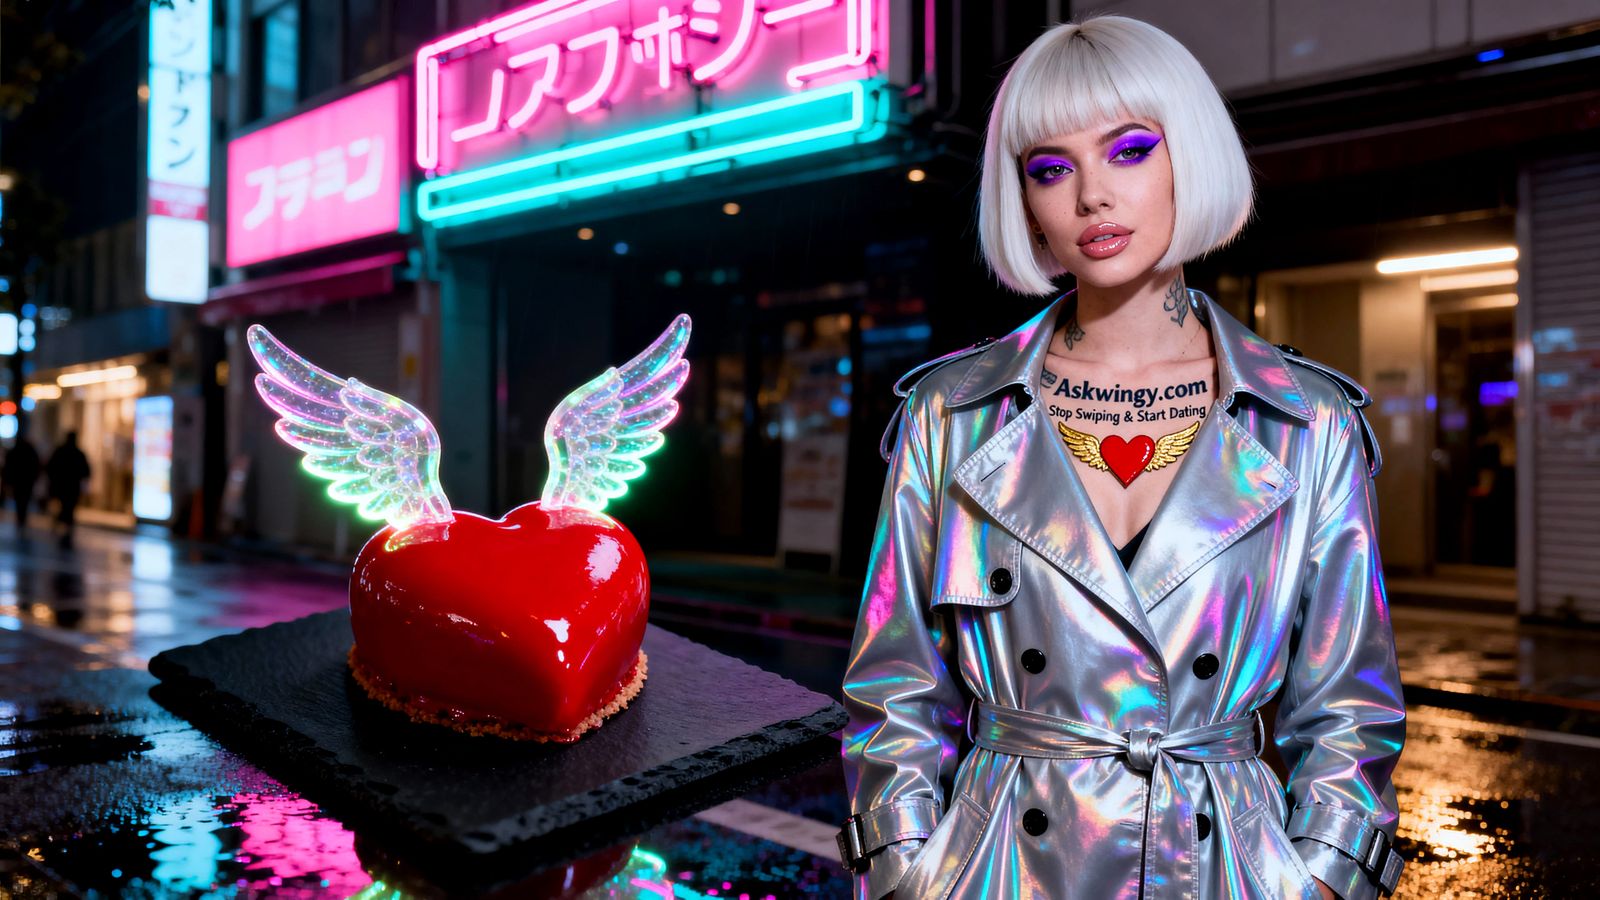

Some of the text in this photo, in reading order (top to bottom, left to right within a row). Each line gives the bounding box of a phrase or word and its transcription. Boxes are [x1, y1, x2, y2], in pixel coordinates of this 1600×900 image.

[1053, 378, 1208, 408] Askwingy.com
[1049, 405, 1207, 425] Stop Swiping & Start Dating
